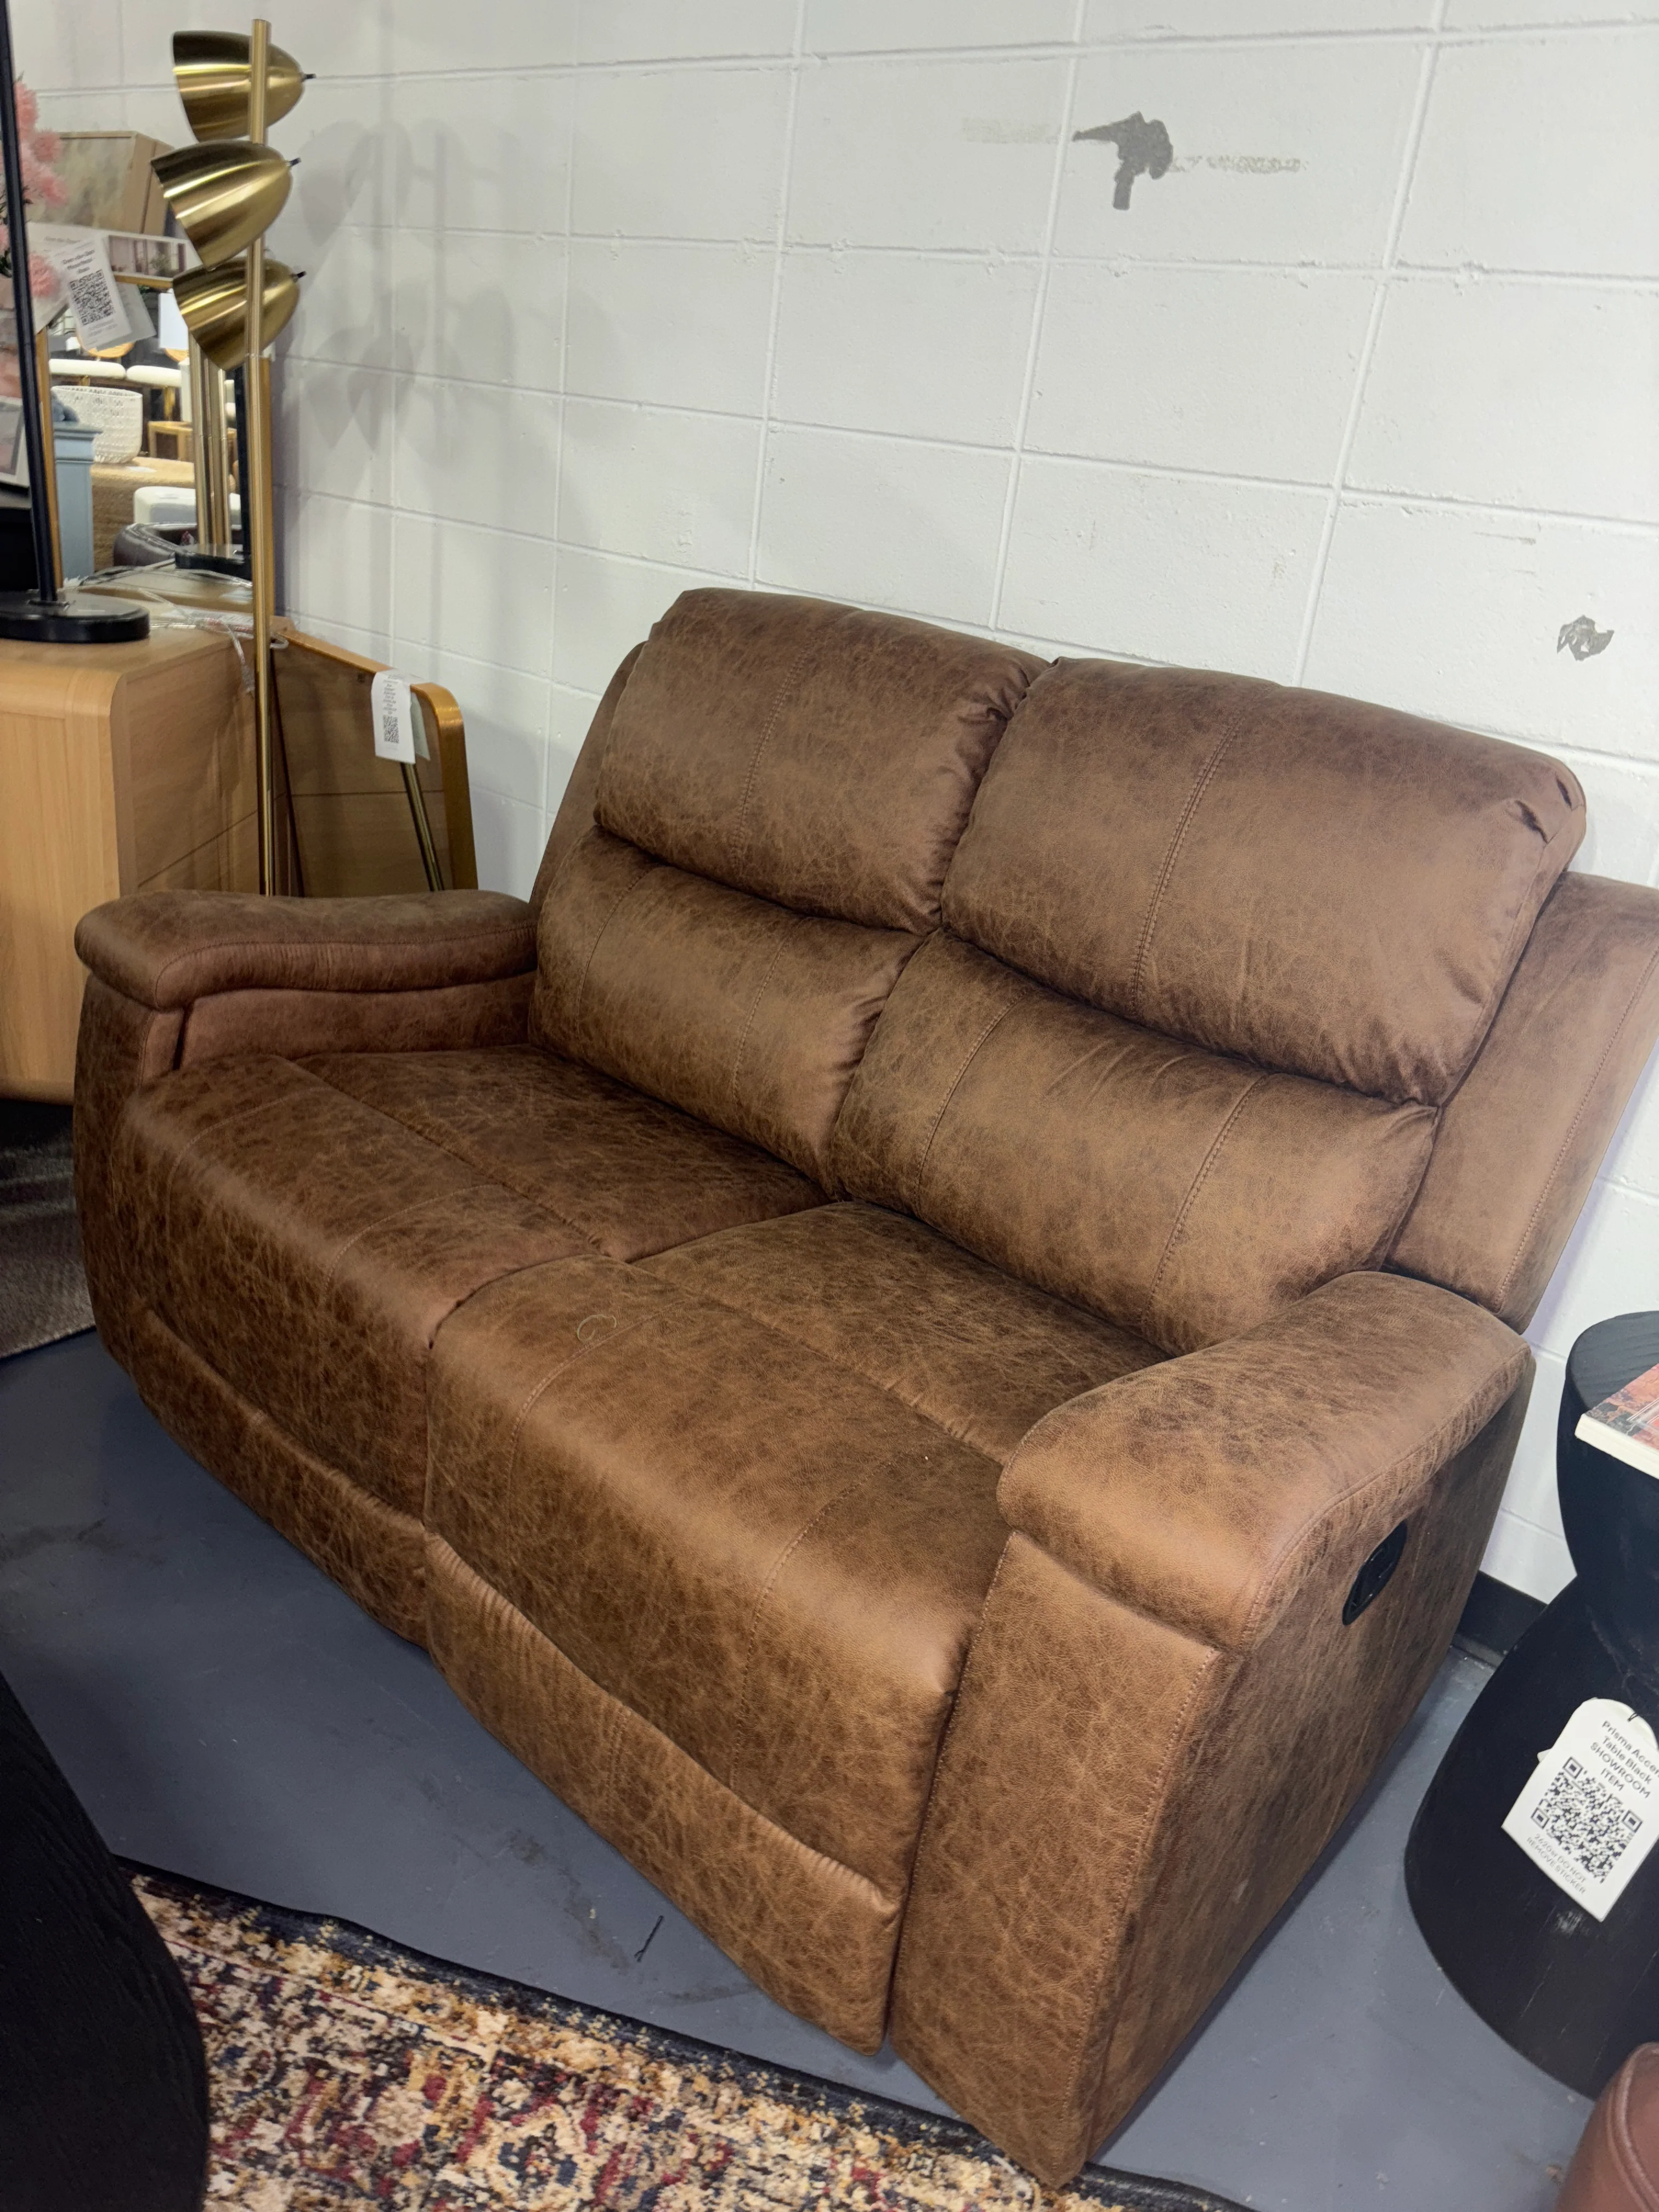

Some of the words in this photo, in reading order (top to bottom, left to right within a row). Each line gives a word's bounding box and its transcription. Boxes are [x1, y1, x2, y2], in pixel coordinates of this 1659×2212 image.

[1602, 1720, 1632, 1751] Prisma
[1590, 1742, 1651, 1798] SHOWROOM
[1600, 1768, 1624, 1791] ITEM
[1602, 1736, 1626, 1760] Table
[1625, 1758, 1652, 1784] Black
[1527, 1837, 1556, 1867] REMOVE
[1555, 1865, 1586, 1894] STICKER
[1557, 1856, 1570, 1869] DO
[1570, 1867, 1586, 1883] NOT
